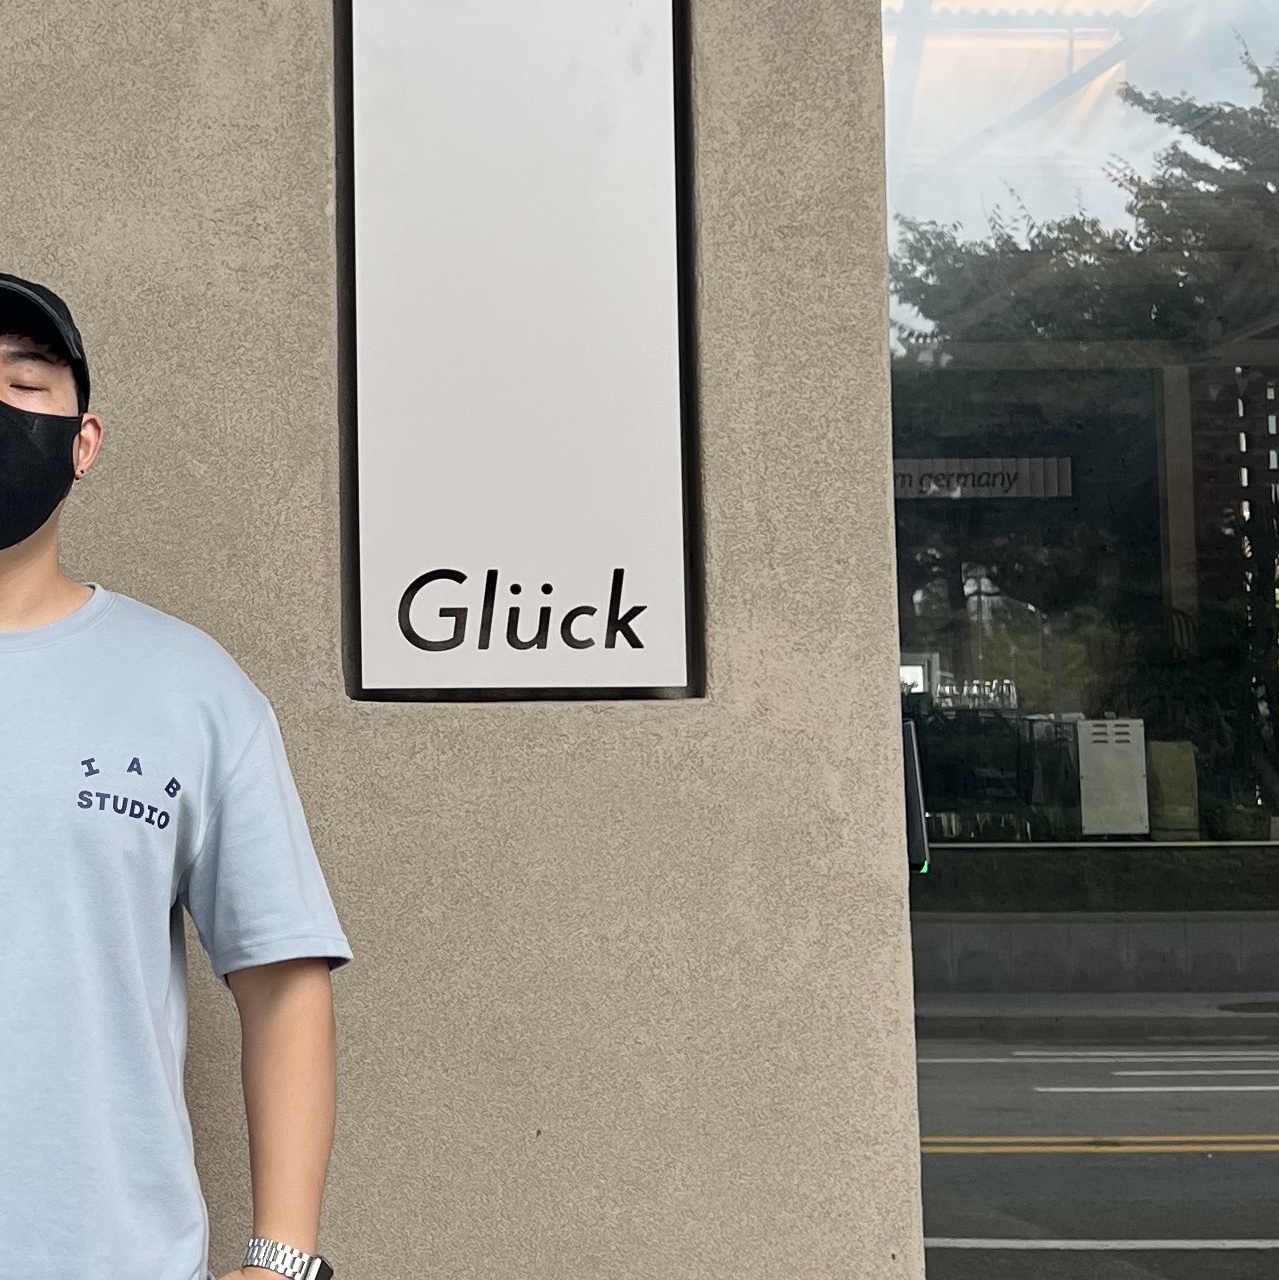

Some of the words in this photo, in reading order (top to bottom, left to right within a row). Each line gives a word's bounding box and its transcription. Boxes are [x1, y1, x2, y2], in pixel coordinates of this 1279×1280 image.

[919, 470, 1018, 494] germany
[397, 567, 648, 652] Glück
[77, 790, 170, 830] STUDIO
